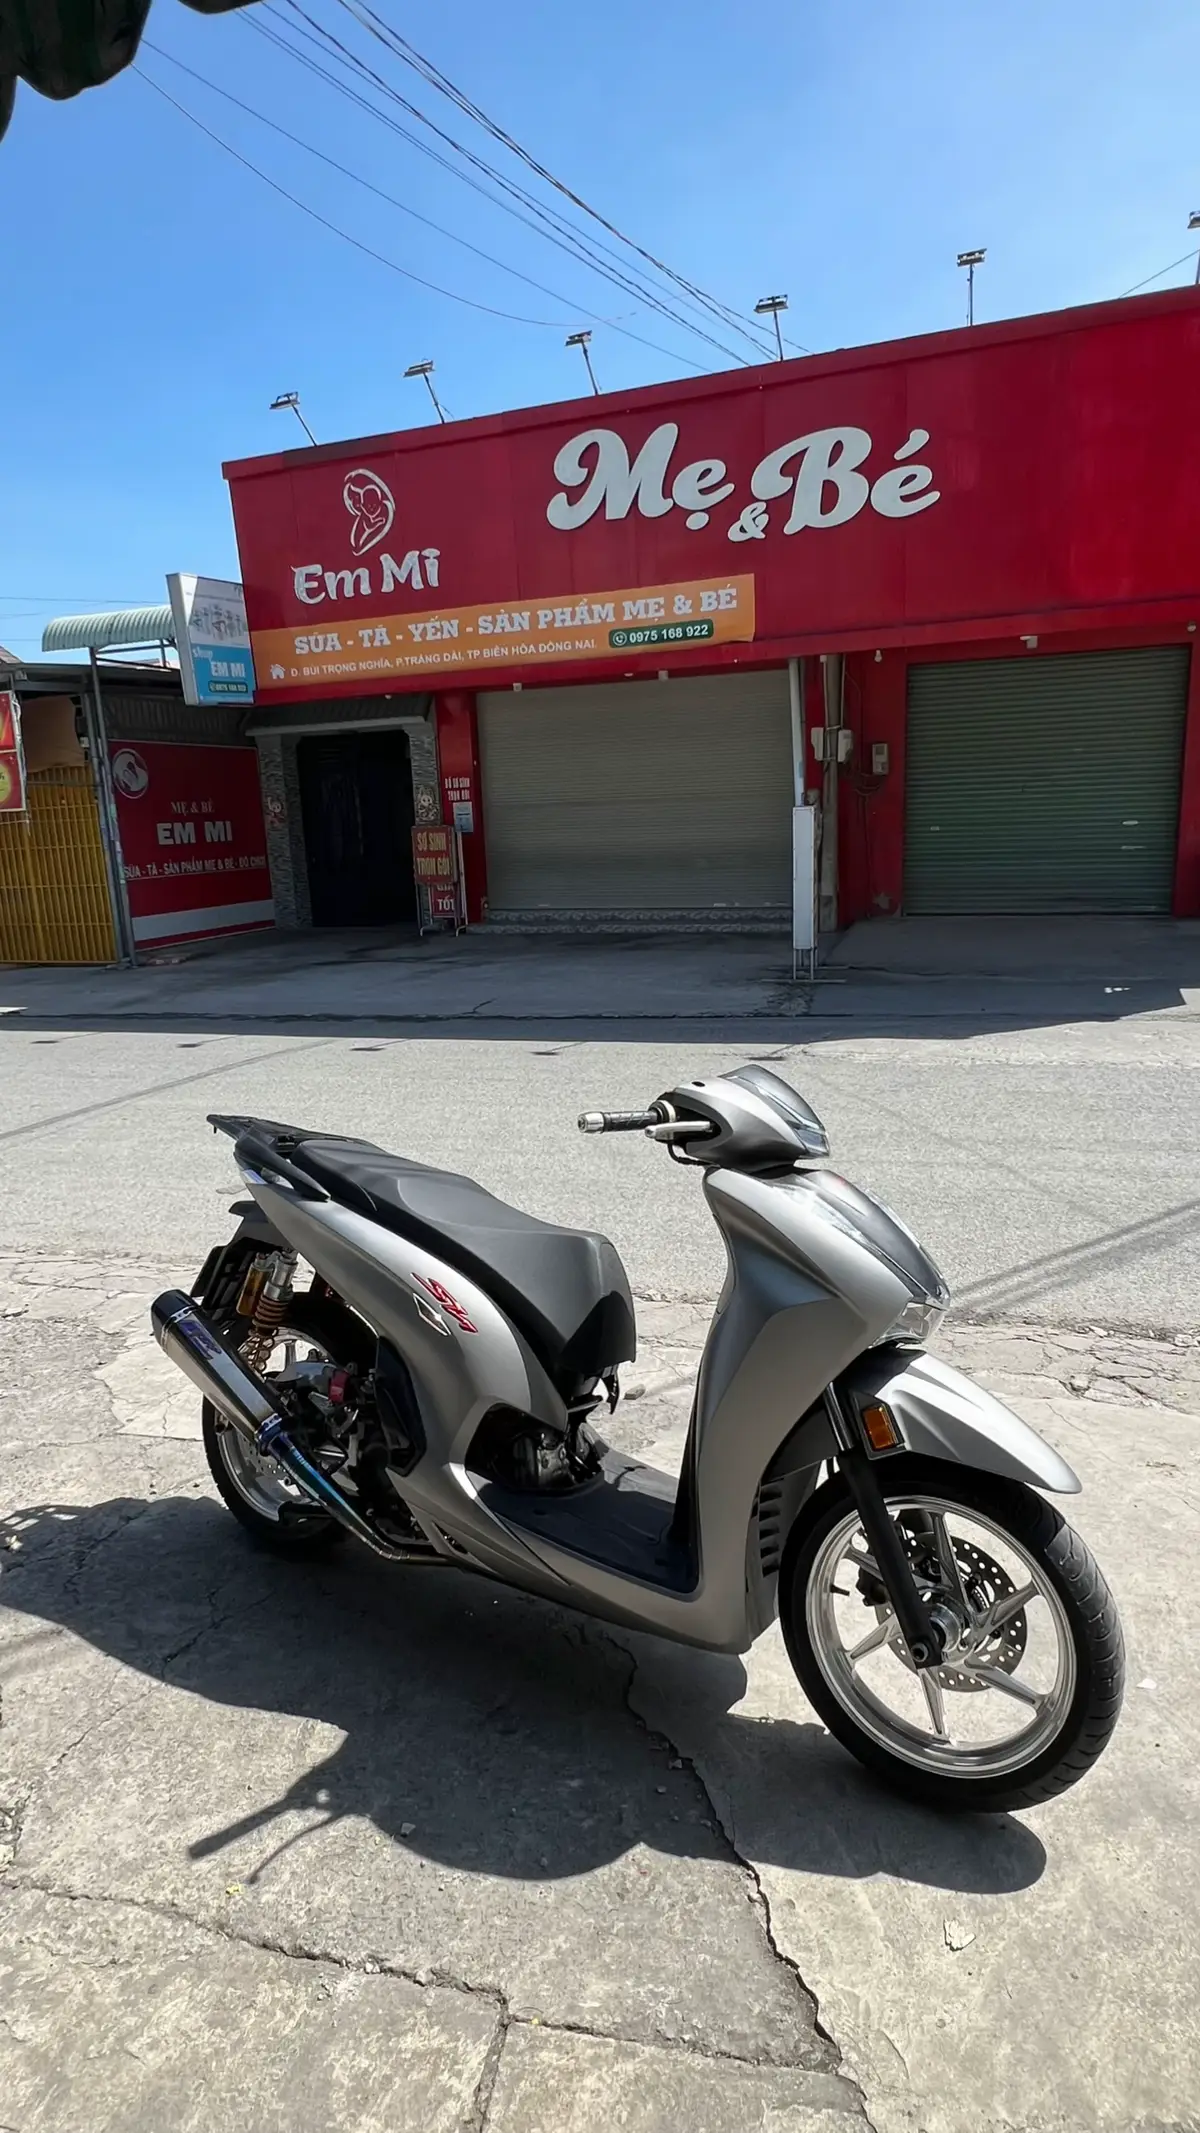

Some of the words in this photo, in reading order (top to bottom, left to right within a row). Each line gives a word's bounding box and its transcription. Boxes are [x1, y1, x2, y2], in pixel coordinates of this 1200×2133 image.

[546, 422, 735, 530] Mẹ
[727, 501, 769, 542] &
[751, 427, 940, 535] Bé
[290, 563, 372, 605] Em
[408, 615, 460, 642] YẾN
[478, 609, 531, 635] SẢN
[537, 598, 615, 630] PHẨM
[622, 596, 665, 622] MẸ
[672, 594, 693, 615] &
[700, 583, 737, 612] BÉ
[629, 629, 658, 643] 0975
[661, 626, 683, 640] 168
[686, 624, 709, 637] 922
[322, 661, 357, 675] TRỌNG
[467, 649, 481, 660] TP
[156, 821, 196, 845] EM
[204, 820, 233, 843] MI
